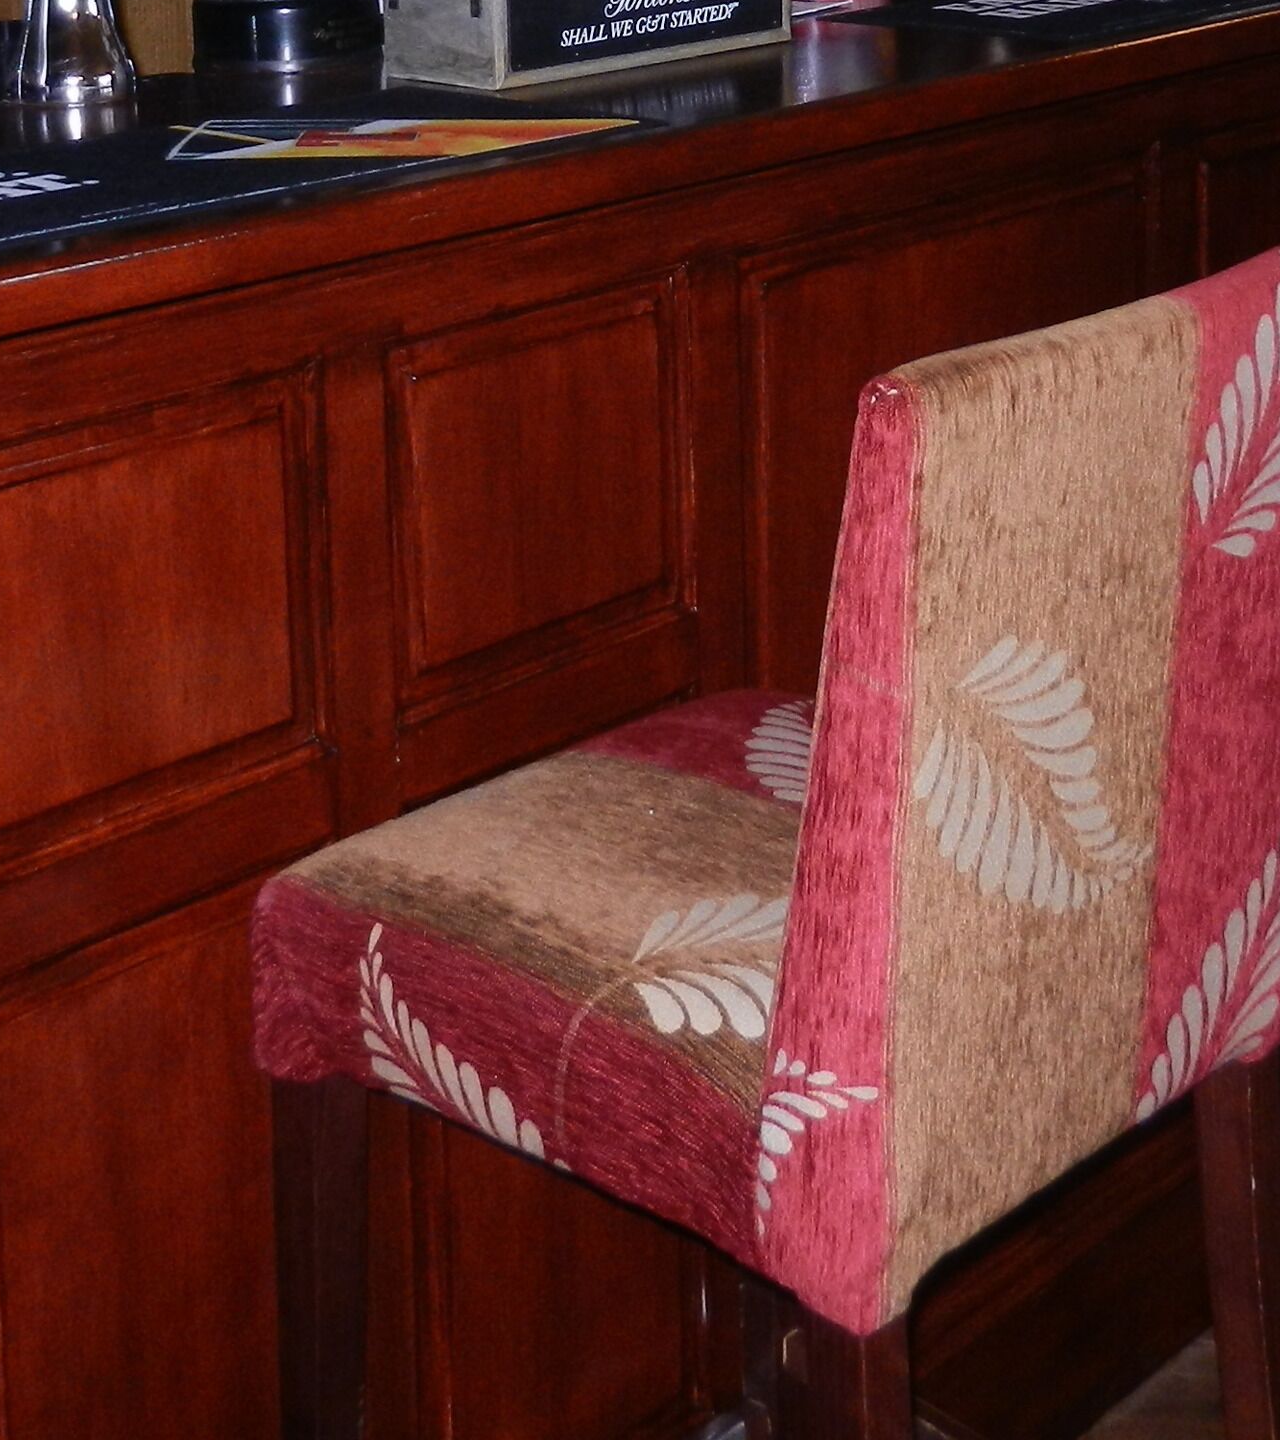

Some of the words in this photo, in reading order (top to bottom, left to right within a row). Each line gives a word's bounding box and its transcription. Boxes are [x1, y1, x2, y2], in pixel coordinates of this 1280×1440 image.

[560, 23, 608, 47] SHALL
[611, 18, 634, 38] WE
[636, 13, 670, 35] G&T
